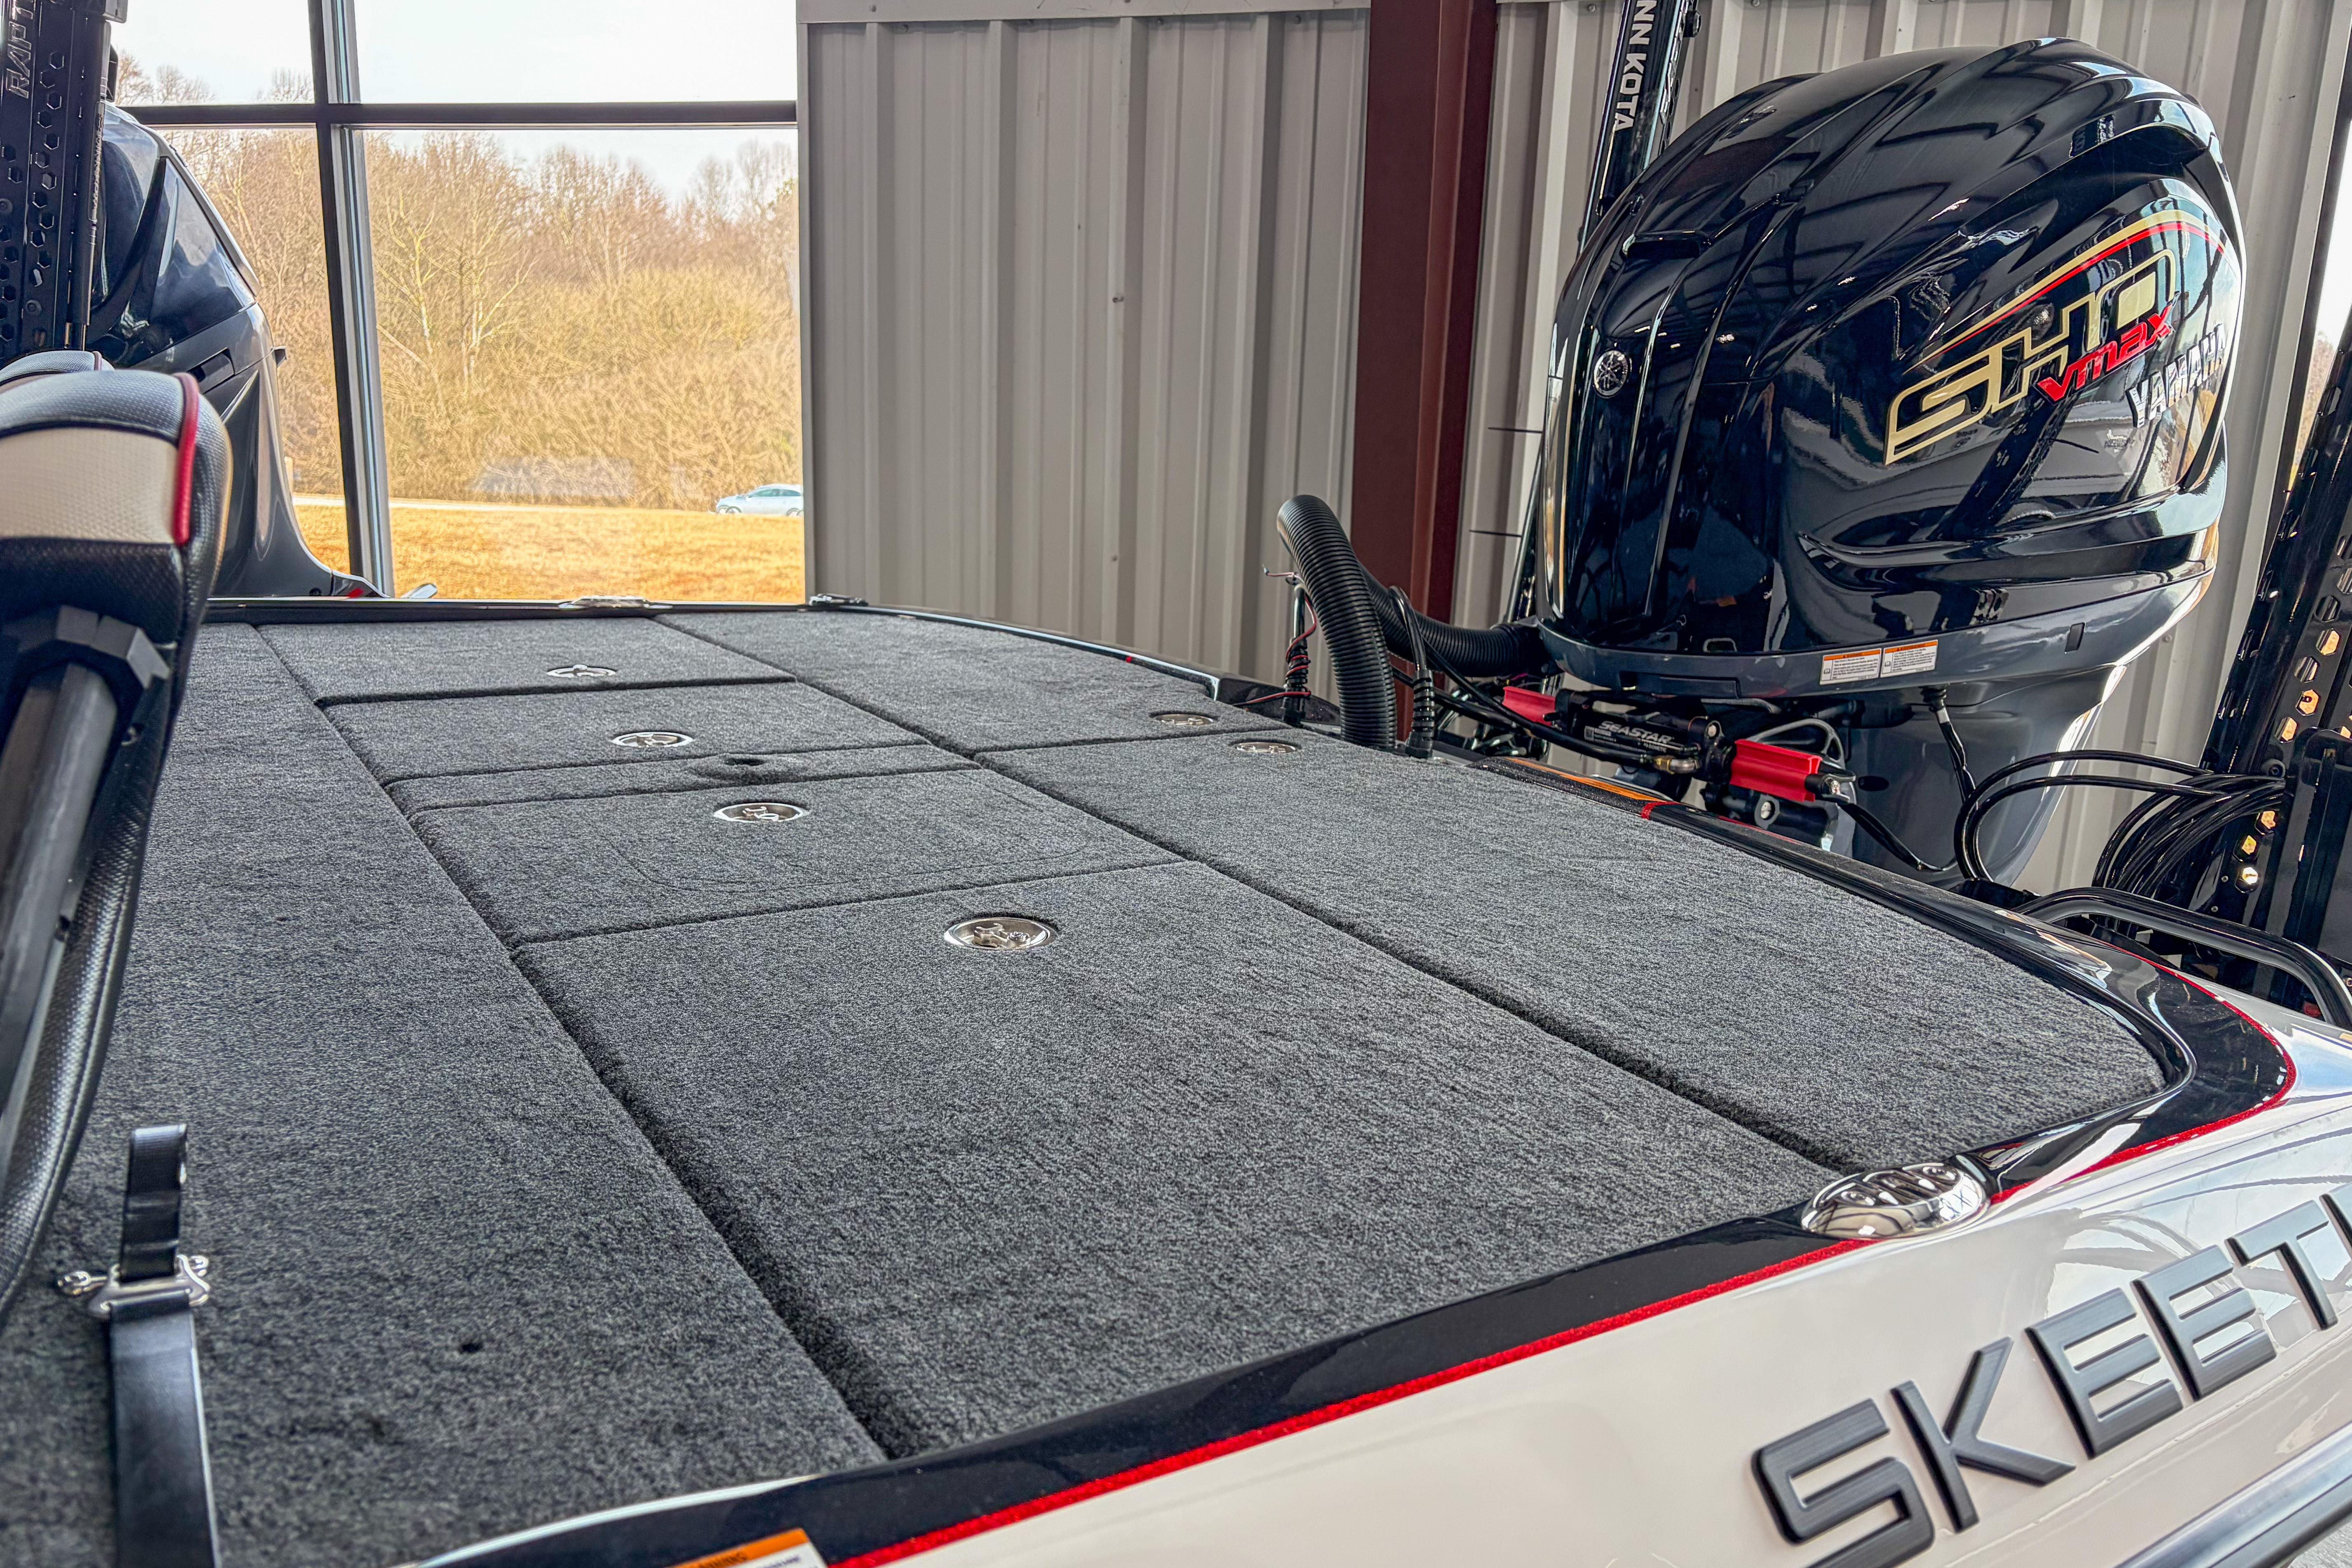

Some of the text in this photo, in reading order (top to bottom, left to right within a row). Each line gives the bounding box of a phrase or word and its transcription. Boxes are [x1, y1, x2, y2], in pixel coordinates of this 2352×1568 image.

[1615, 53, 1647, 131] KOTA
[1884, 249, 2176, 466] SHO
[2126, 323, 2225, 428] YAMAHA
[1598, 721, 1673, 744] SEASTAR
